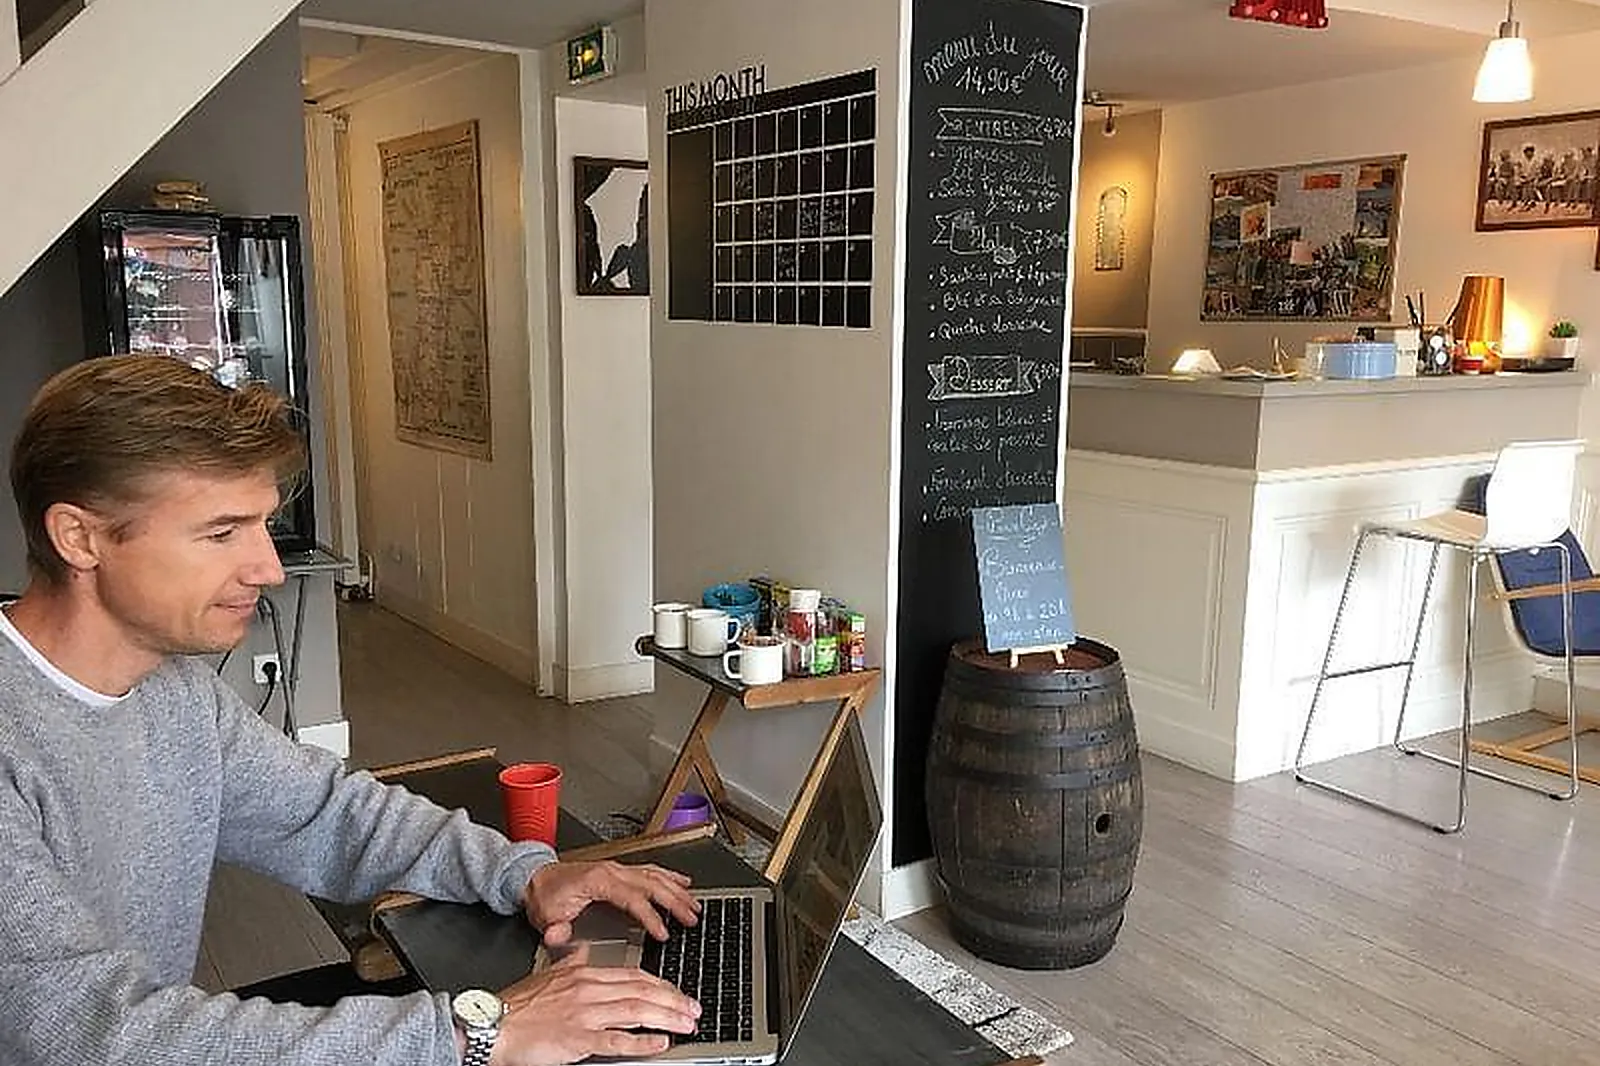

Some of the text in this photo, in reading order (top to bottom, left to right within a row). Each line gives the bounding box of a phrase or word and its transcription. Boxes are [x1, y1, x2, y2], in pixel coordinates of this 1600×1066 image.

[985, 20, 1019, 55] du
[665, 82, 697, 114] THIS
[700, 65, 765, 107] MONTH
